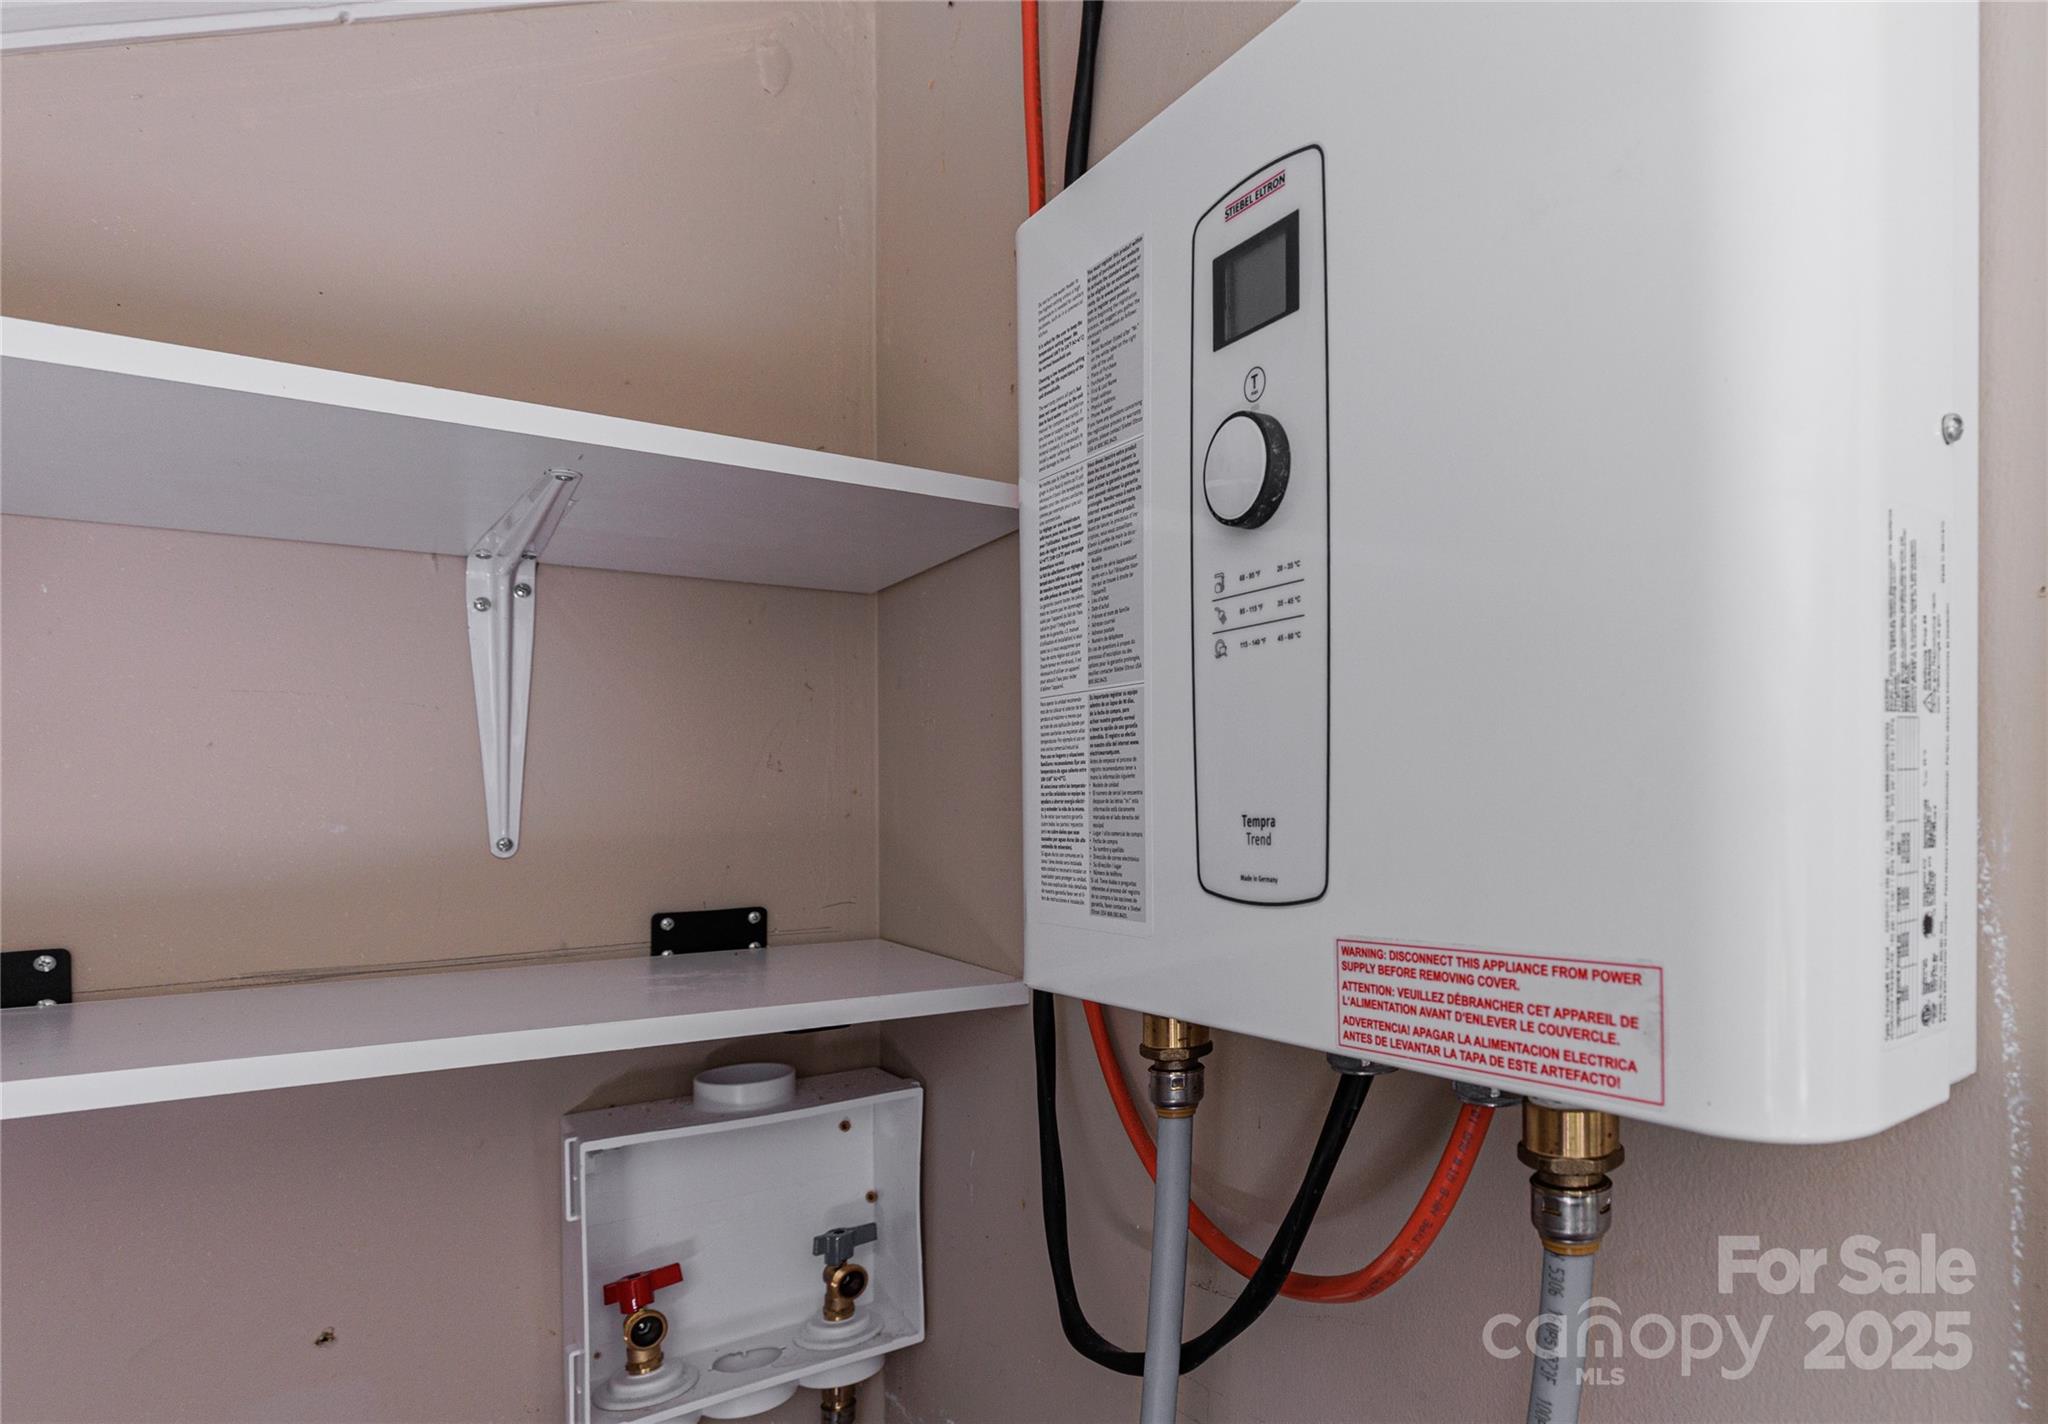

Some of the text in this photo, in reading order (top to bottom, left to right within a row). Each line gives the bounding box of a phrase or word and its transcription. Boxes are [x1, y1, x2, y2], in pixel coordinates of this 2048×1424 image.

[1224, 174, 1286, 218] STIEBEL ELTRON
[1251, 374, 1258, 389] T
[1242, 814, 1276, 830] Tempra
[1246, 832, 1272, 846] Trend
[1258, 875, 1278, 884] Germany
[1341, 946, 1643, 986] WARNING: DISCONNECT THIS APPLIANCE FROM POWER
[1341, 961, 1520, 991] SUPPLY BEFORE REMOVING COVER.
[1342, 981, 1639, 1029] ATTENTION: VEUILLEZ DÉBRANCHER CET APPAREIL DE
[1342, 996, 1620, 1046] L'ALIMENTATION AVANT D'ENLEVER LE COUVERCLE.
[1342, 1016, 1638, 1073] ADVERTENCIA! APAGAR LA ALIMENTACION ELECTRICA
[1343, 1030, 1621, 1089] ANTES DE LEVANTAR LA TAPA DE ESTE ARTEFACTO!
[1548, 1264, 1564, 1298] 5306
